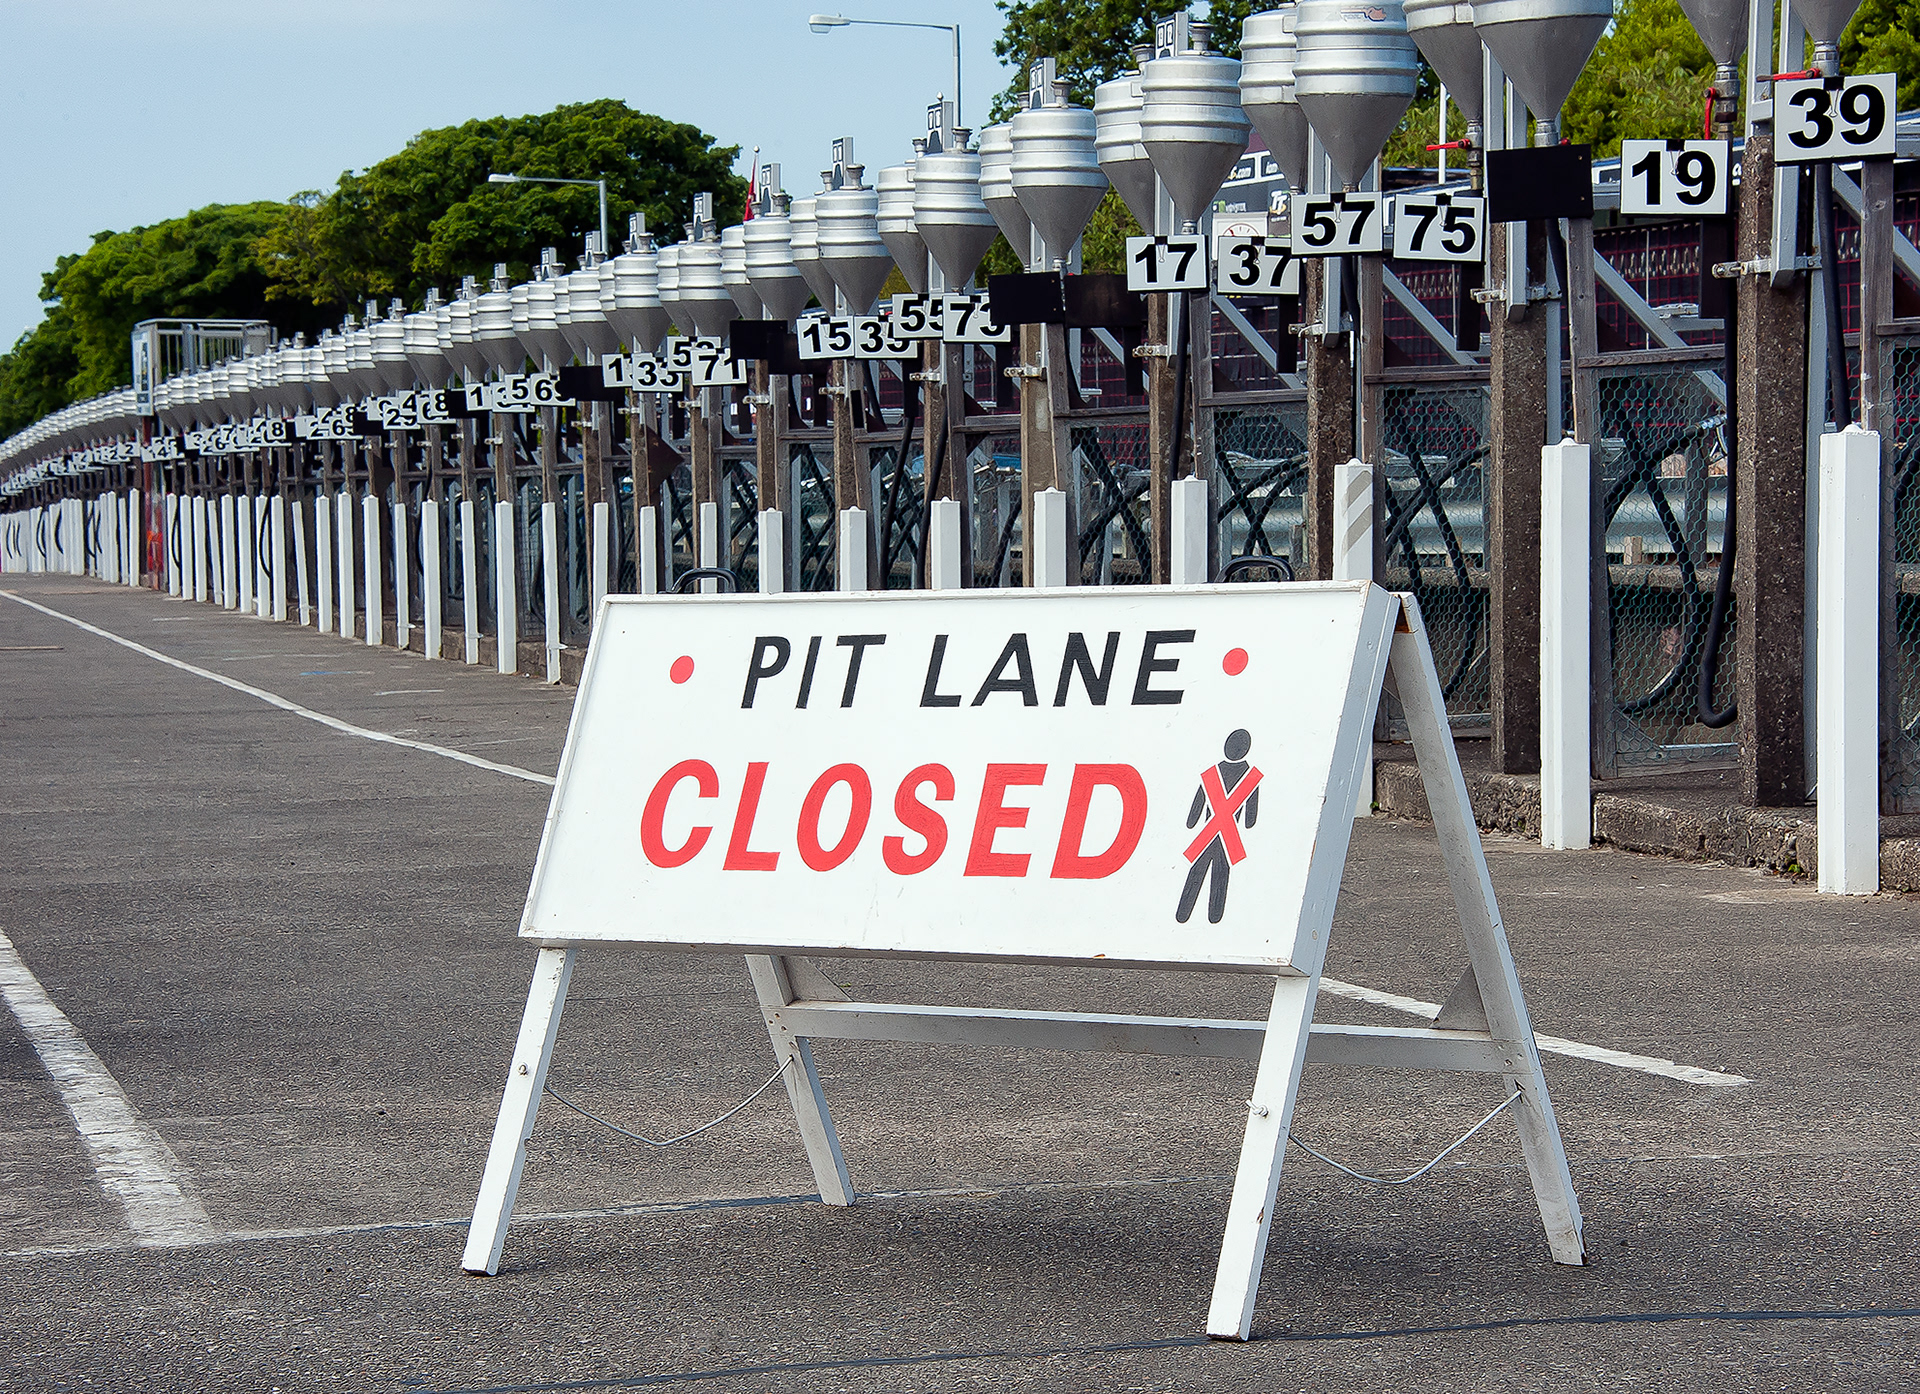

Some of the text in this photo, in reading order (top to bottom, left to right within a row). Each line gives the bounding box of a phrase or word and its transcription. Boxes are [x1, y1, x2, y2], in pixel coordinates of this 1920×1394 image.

[1787, 84, 1886, 149] 39
[1632, 150, 1716, 206] 19
[1301, 200, 1376, 246] 57
[1404, 204, 1476, 254] 75
[1135, 243, 1197, 283] 17
[1229, 243, 1292, 287] 37
[803, 322, 851, 353] 15
[512, 378, 529, 400] 5
[608, 358, 633, 382] 1
[699, 354, 740, 381] 71
[470, 386, 483, 407] 1
[741, 630, 1196, 709] PIT LANE
[641, 760, 1147, 879] CLOSED
